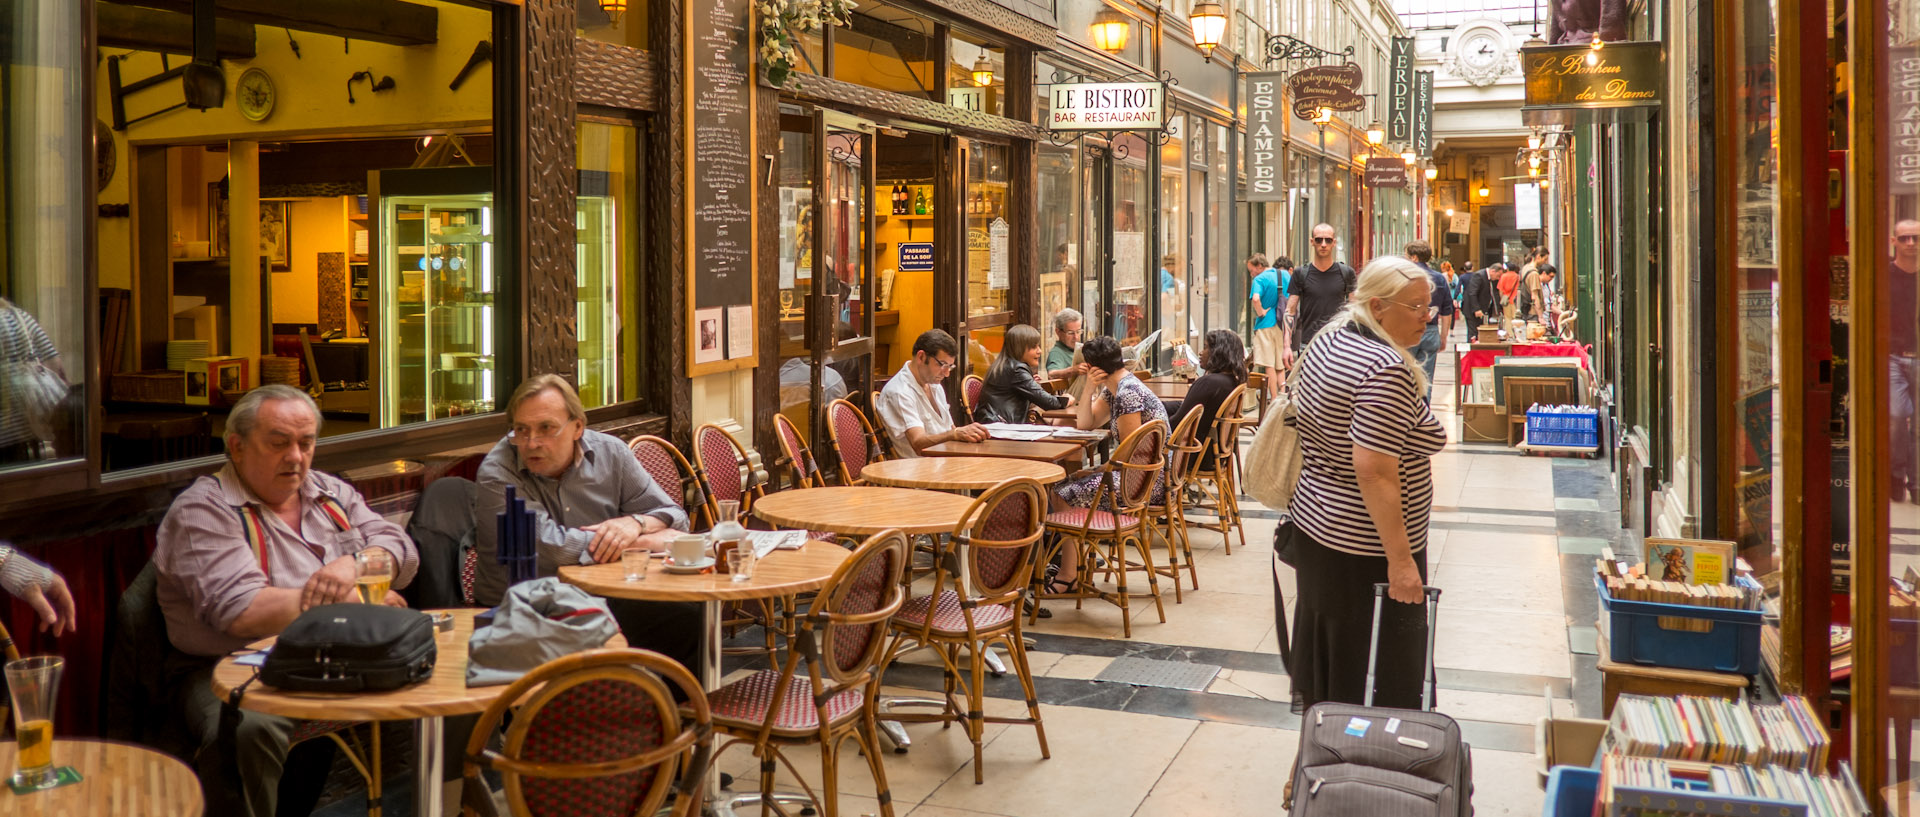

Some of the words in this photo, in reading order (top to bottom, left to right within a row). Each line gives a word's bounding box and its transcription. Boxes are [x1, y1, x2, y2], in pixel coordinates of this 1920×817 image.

[1533, 56, 1557, 76] Le
[1555, 54, 1621, 76] Bonheur
[1293, 72, 1352, 88] Photographies
[1393, 41, 1410, 138] VERDEAU
[1575, 86, 1596, 101] des
[1601, 78, 1655, 100] Dames
[1055, 89, 1076, 109] LE
[1084, 88, 1157, 109] BISTROT
[1054, 112, 1076, 123] BAR
[1084, 111, 1157, 123] RESTAURANT
[1418, 74, 1428, 156] RESTAURANT
[1254, 81, 1274, 193] ESTAMPES
[764, 154, 775, 186] 7
